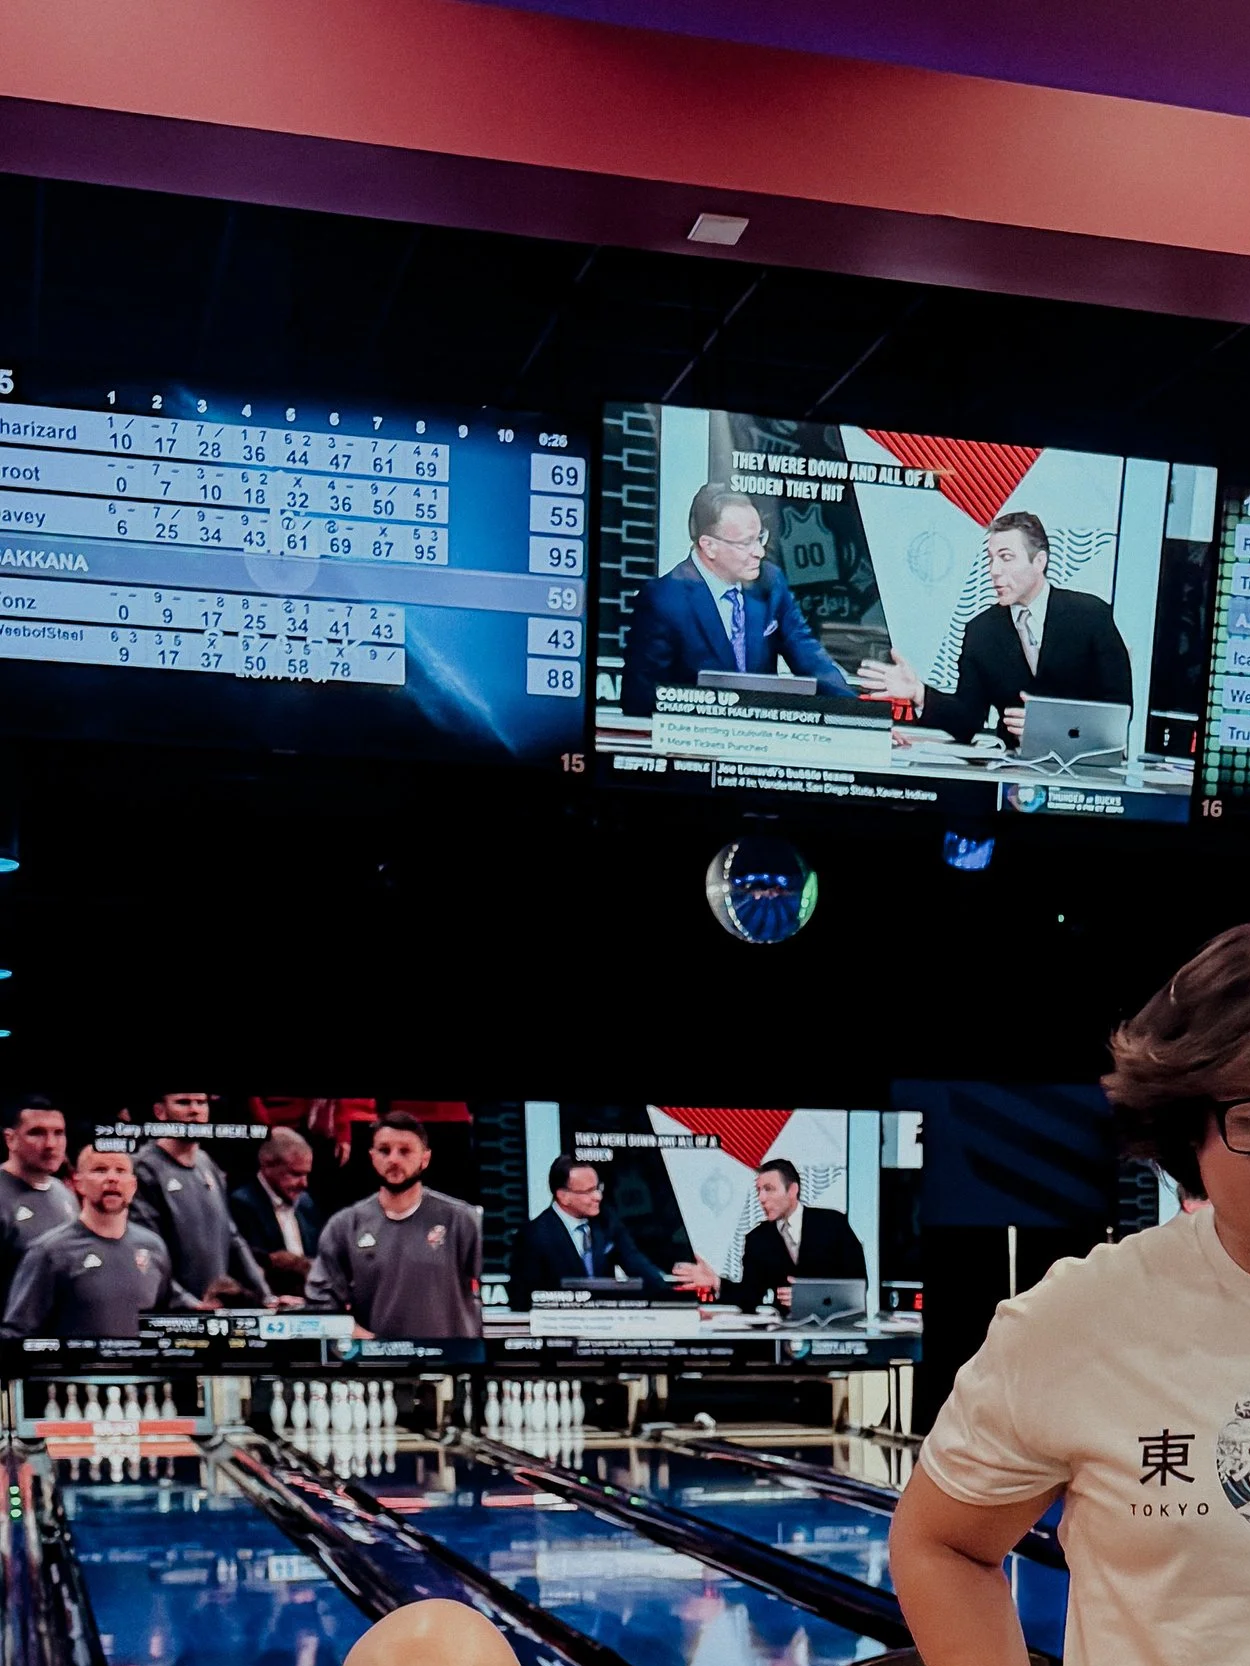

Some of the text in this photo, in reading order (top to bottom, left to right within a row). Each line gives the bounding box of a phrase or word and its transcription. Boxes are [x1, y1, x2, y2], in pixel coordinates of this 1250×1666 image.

[0, 418, 578, 486] harizard 10 17 28 36 44 47 61 69 69
[732, 451, 935, 489] THEY WERE DOWN AND ALL OF A
[2, 467, 577, 527] root 0 7 10 18 32 36 50 55 55
[730, 472, 845, 502] SUDDEN THEY HIT
[2, 510, 576, 568] avey 6 25 34 43 61 69 87 95 95
[547, 587, 576, 610] 59
[548, 630, 574, 649] 43
[547, 669, 574, 689] 88
[656, 687, 739, 706] COMING UP
[780, 710, 821, 723] REPORT
[561, 753, 584, 772] 15
[1202, 800, 1222, 817] 16
[1130, 1502, 1210, 1517] TOKYO
